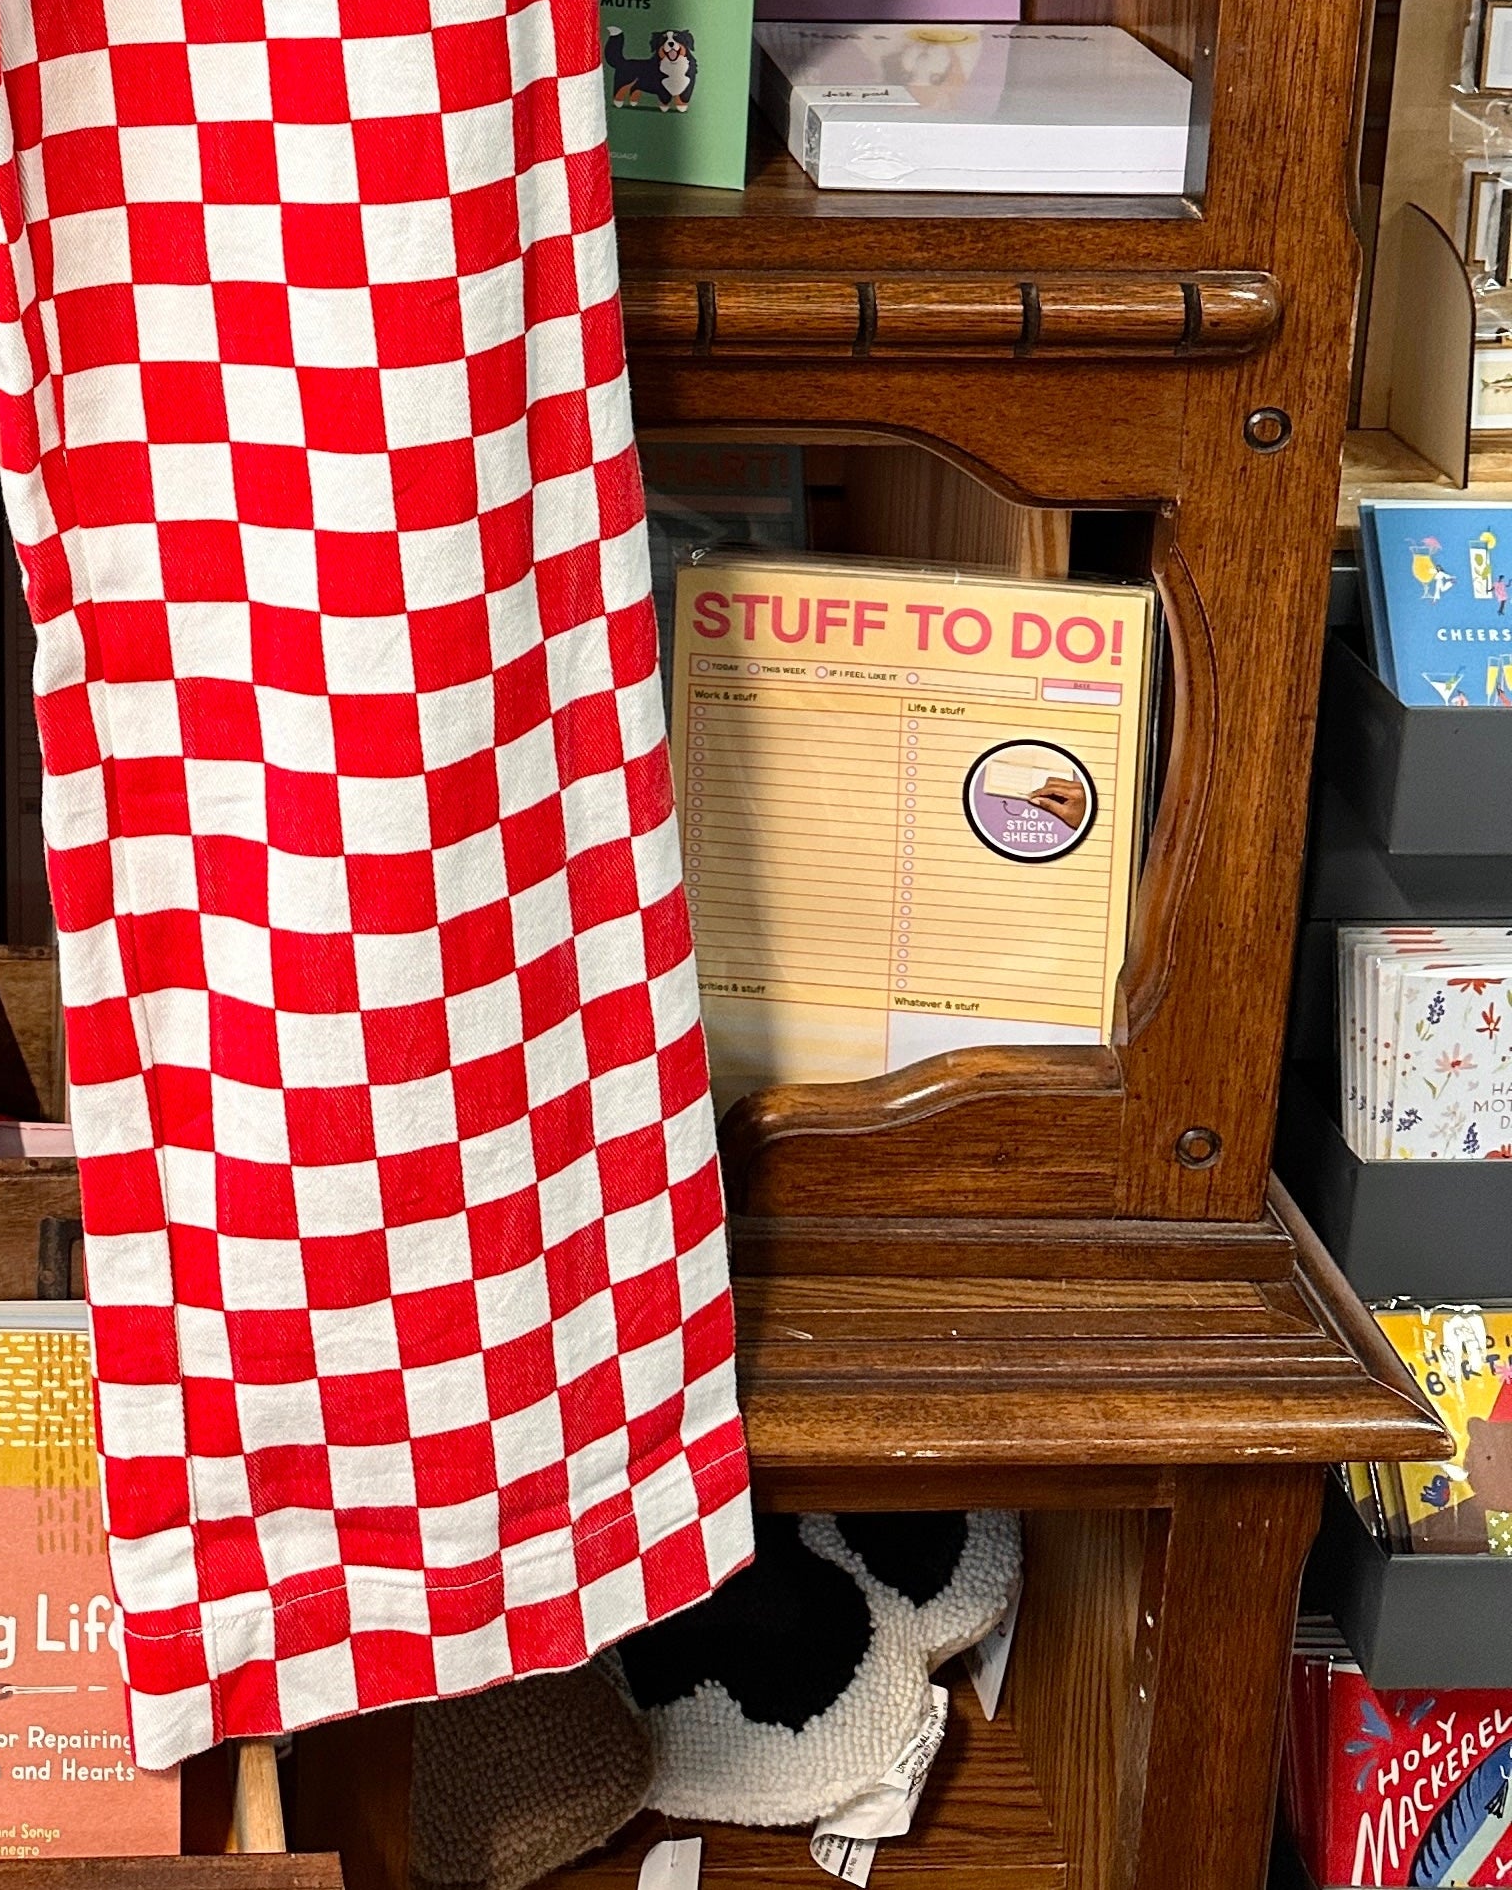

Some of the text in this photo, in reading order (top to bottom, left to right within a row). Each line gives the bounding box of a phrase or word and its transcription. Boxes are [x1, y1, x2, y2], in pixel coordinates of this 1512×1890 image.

[692, 591, 1124, 666] STUFF TO DO!
[1437, 628, 1512, 642] CHEERS
[711, 663, 739, 672] TODAY
[761, 665, 781, 674] THIS
[783, 666, 807, 675] WEEK
[829, 669, 838, 677] IF
[844, 670, 866, 679] FEEL
[868, 672, 887, 681] LIKE
[889, 673, 898, 681] IT
[694, 690, 758, 702] Work & stuff
[907, 703, 966, 716] Life & stuff
[1021, 808, 1039, 819] 40
[1006, 820, 1055, 831] STICKY
[1002, 831, 1059, 844] SHEETS!
[731, 984, 739, 992] &
[741, 985, 766, 995] stuff
[893, 996, 980, 1012] Whatever & stuff
[1377, 1711, 1457, 1796] HOLY
[11, 1759, 51, 1781] and
[62, 1758, 135, 1782] Hearts
[1350, 1708, 1512, 1887] MACKEREL
[21, 1823, 61, 1843] Sonya
